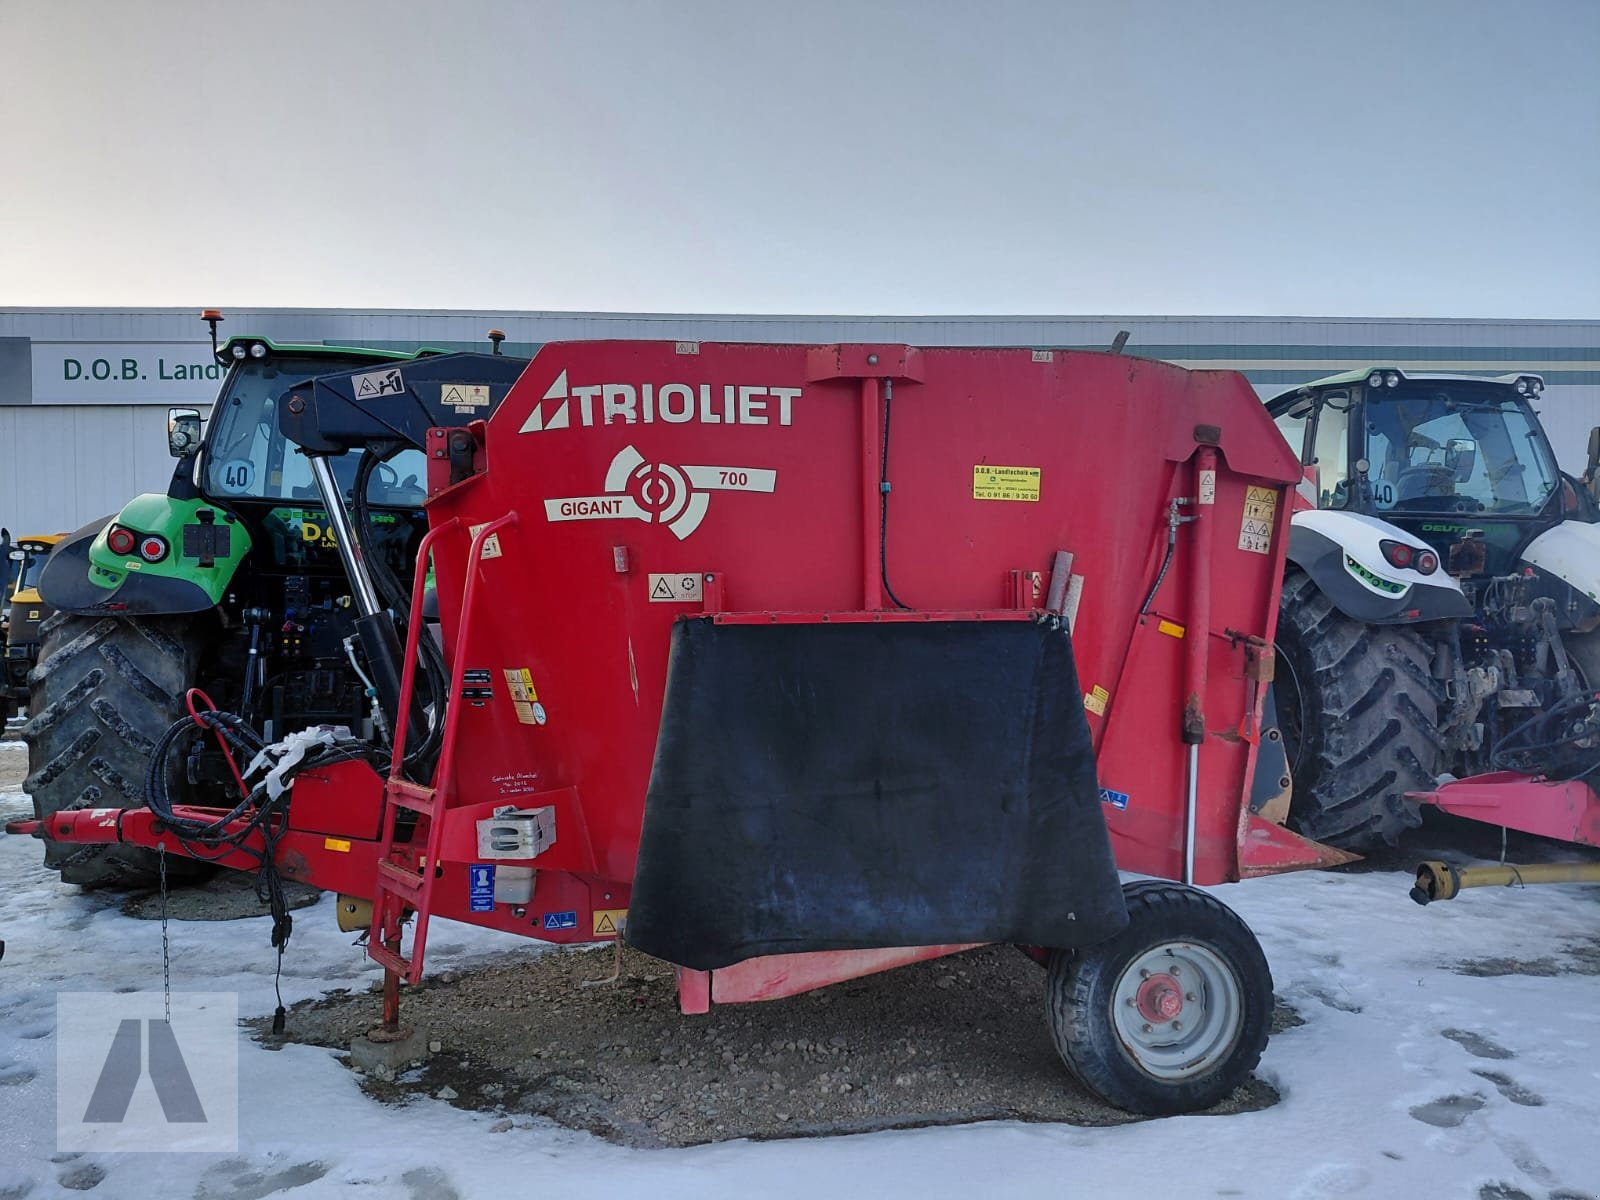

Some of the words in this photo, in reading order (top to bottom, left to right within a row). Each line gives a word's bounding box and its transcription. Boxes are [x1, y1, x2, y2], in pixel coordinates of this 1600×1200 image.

[63, 358, 147, 381] D.O.B.
[570, 383, 803, 427] TRIOLIET
[225, 465, 248, 487] 40
[719, 471, 748, 486] 700
[1374, 484, 1393, 504] 40
[560, 499, 623, 517] GIGANT
